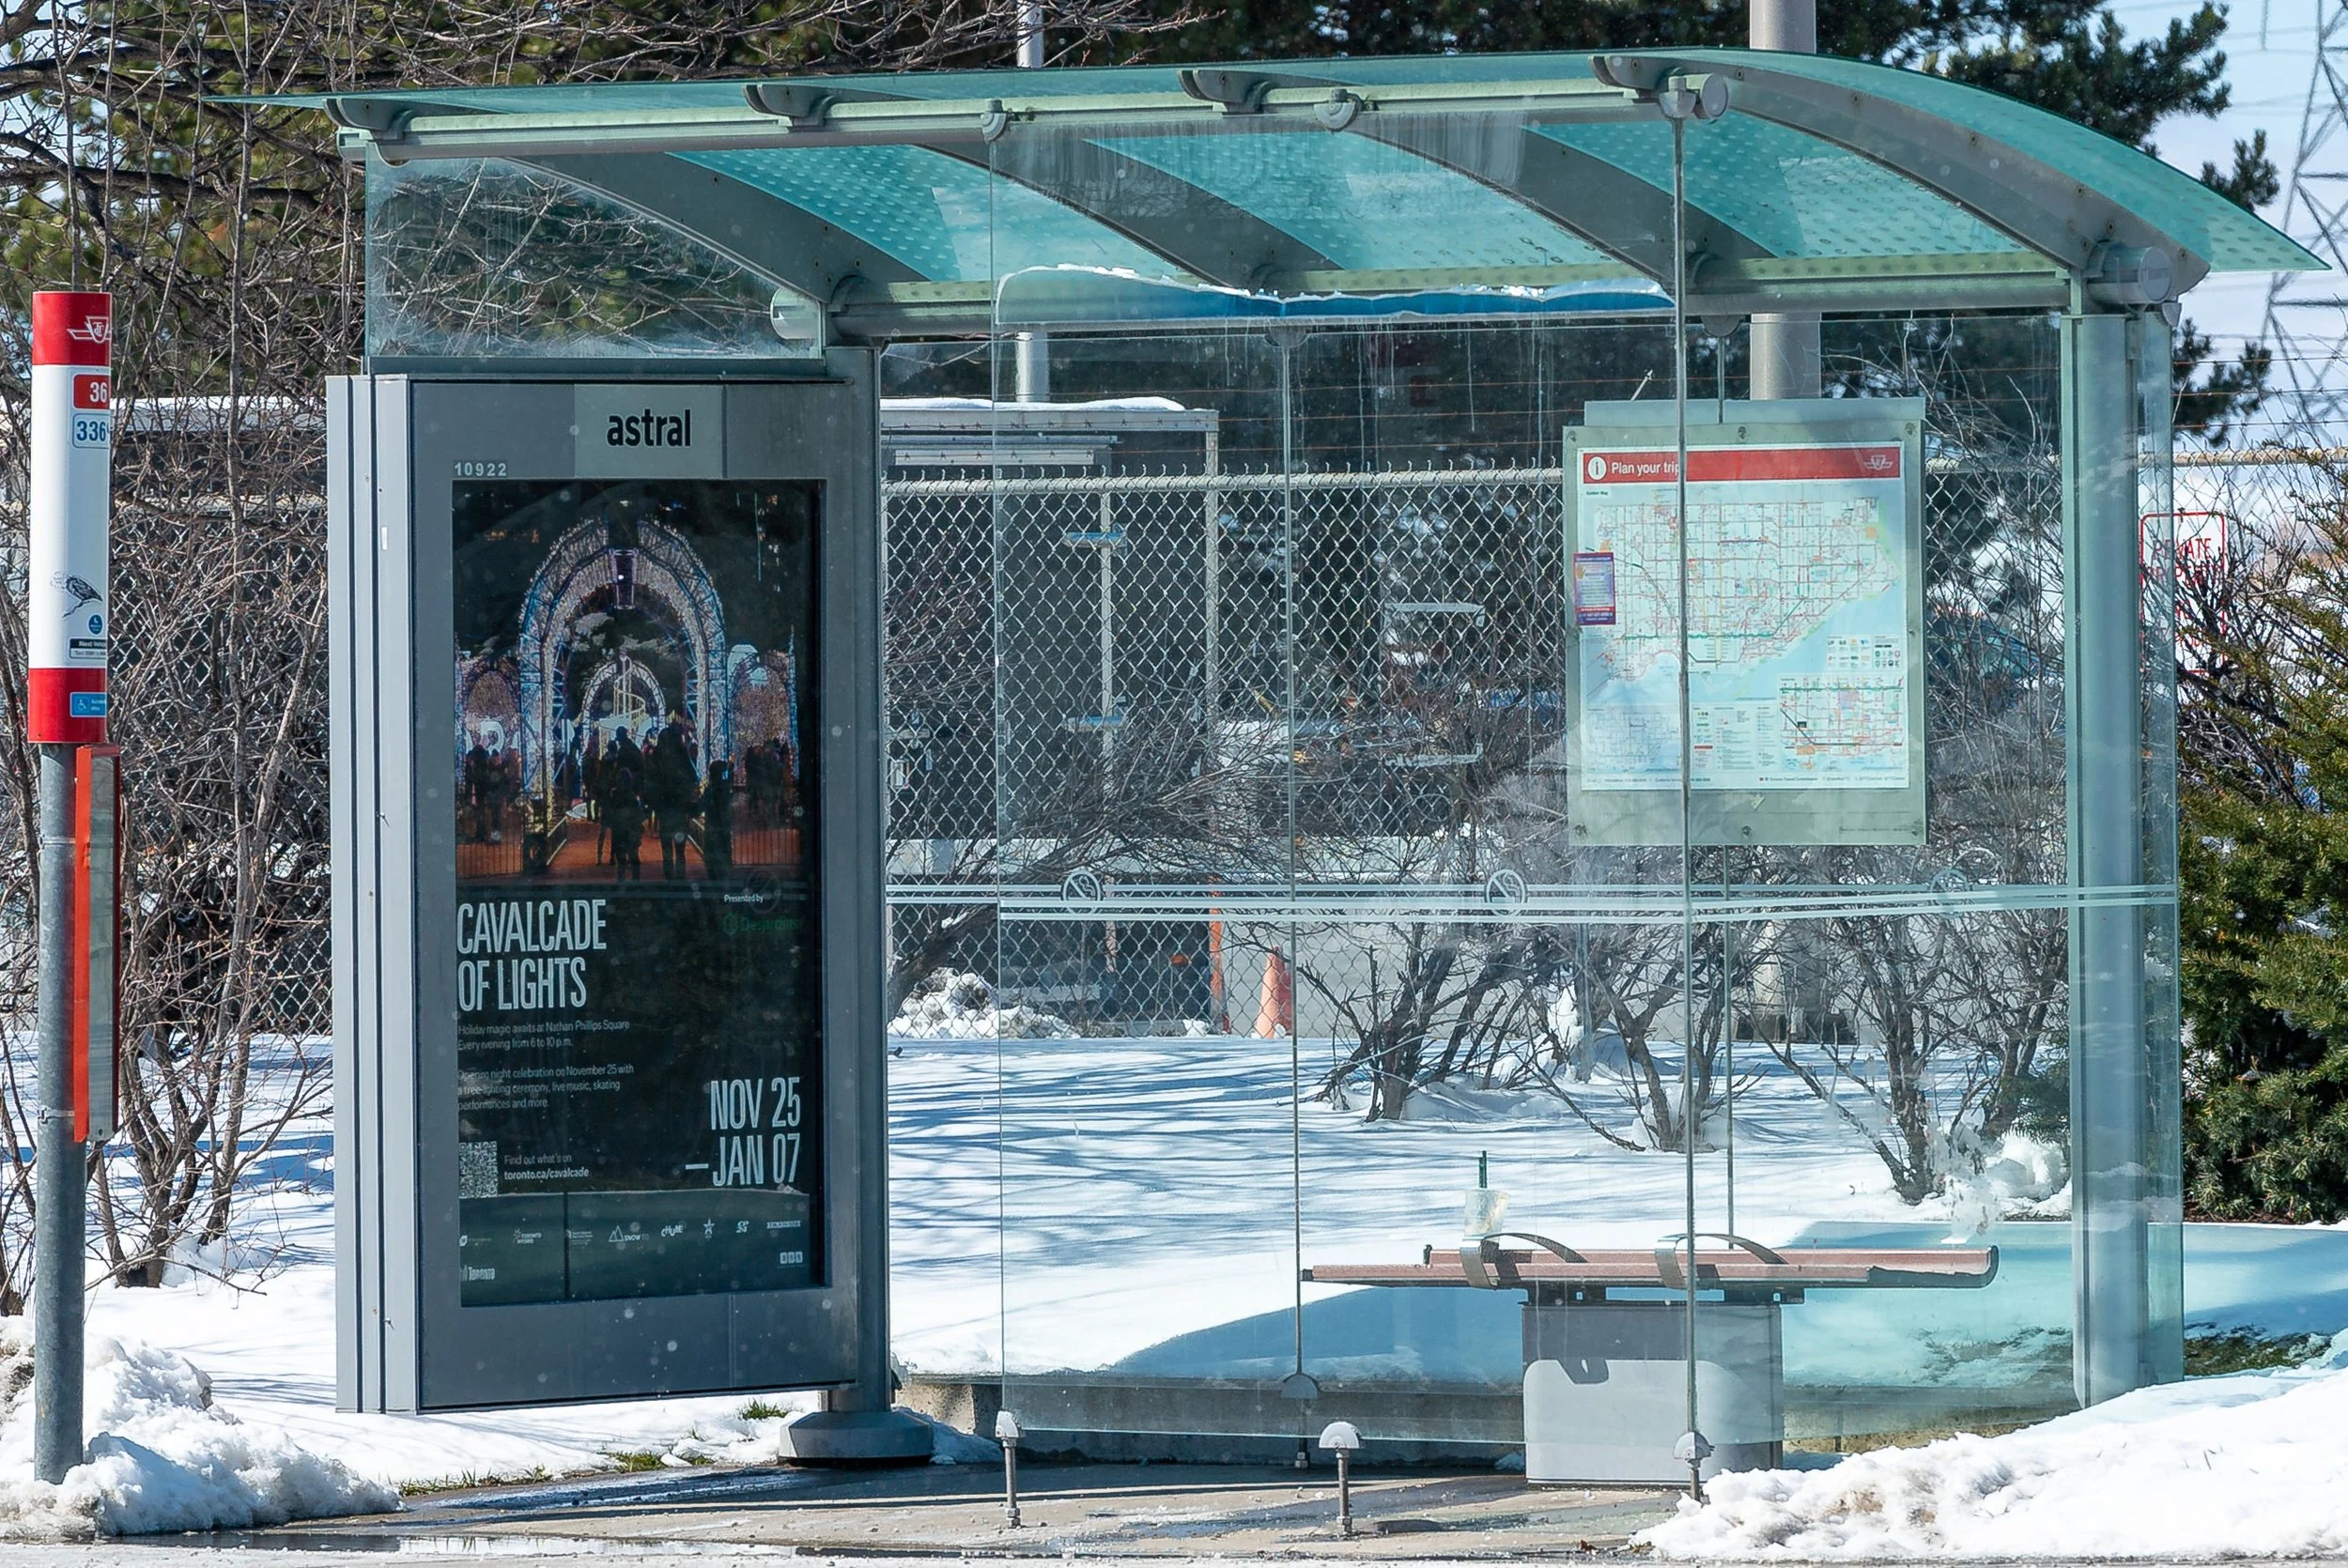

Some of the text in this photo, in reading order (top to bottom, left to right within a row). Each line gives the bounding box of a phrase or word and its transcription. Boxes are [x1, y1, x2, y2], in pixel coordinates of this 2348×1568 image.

[89, 381, 108, 404] 36
[76, 420, 109, 442] 336
[606, 408, 691, 448] astral
[453, 462, 508, 477] 10922
[1611, 461, 1680, 477] Plan your trip
[723, 894, 755, 903] Presented
[456, 899, 608, 955] CAVALCADE
[457, 956, 587, 1012] OF LIGHTS
[458, 1023, 486, 1037] Holiday
[487, 1023, 511, 1036] magic
[546, 1021, 574, 1032] Nathan
[603, 1019, 630, 1031] Square
[512, 1038, 530, 1048] from
[546, 1037, 555, 1047] 10
[512, 1067, 554, 1078] celebration
[566, 1064, 607, 1076] November
[607, 1063, 617, 1074] 25
[618, 1063, 634, 1074] with
[551, 1081, 566, 1092] live
[593, 1079, 621, 1091] skating
[710, 1076, 801, 1130] NOV 25
[503, 1155, 522, 1165] Find
[523, 1156, 536, 1165] out
[712, 1134, 765, 1187] JAN
[773, 1132, 801, 1184] 07
[503, 1166, 590, 1180] toronto.ca/cavalcade
